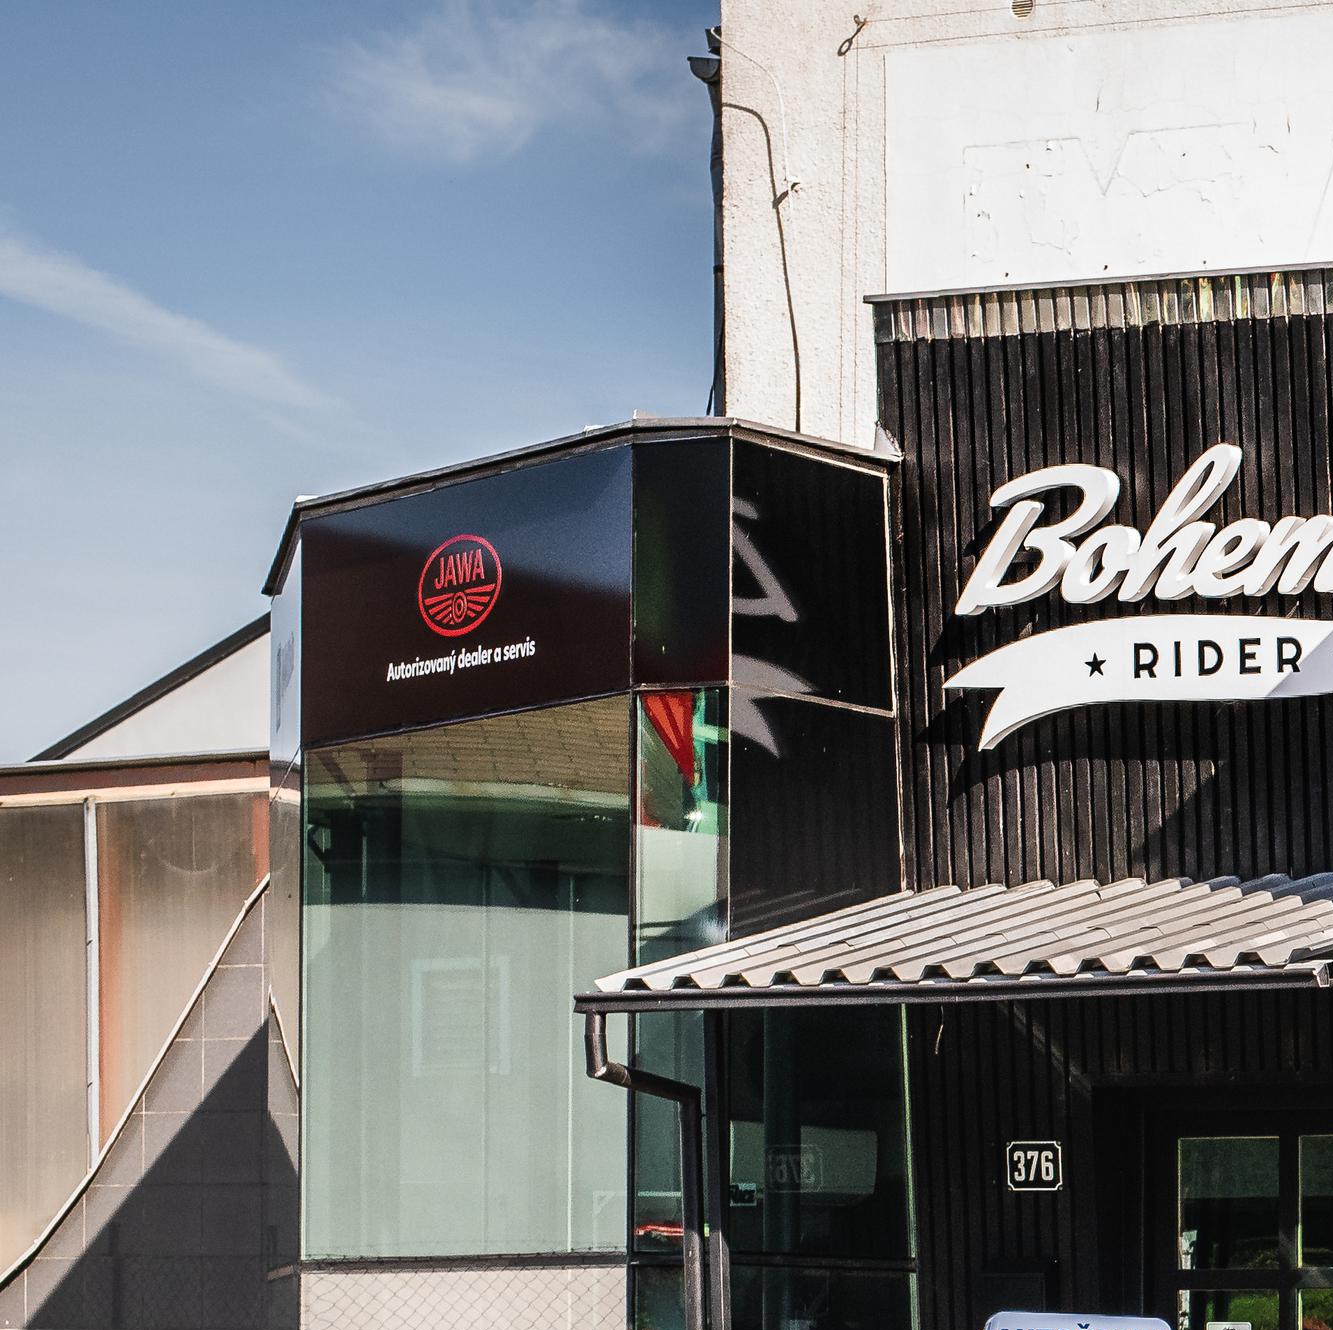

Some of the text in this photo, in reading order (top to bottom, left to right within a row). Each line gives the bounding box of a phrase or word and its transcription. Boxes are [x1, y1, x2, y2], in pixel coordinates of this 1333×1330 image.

[434, 549, 485, 590] JAWA
[386, 636, 536, 682] Autorizovaný dealer a servis
[1133, 636, 1302, 679] RIDER
[1013, 1150, 1054, 1181] 376
